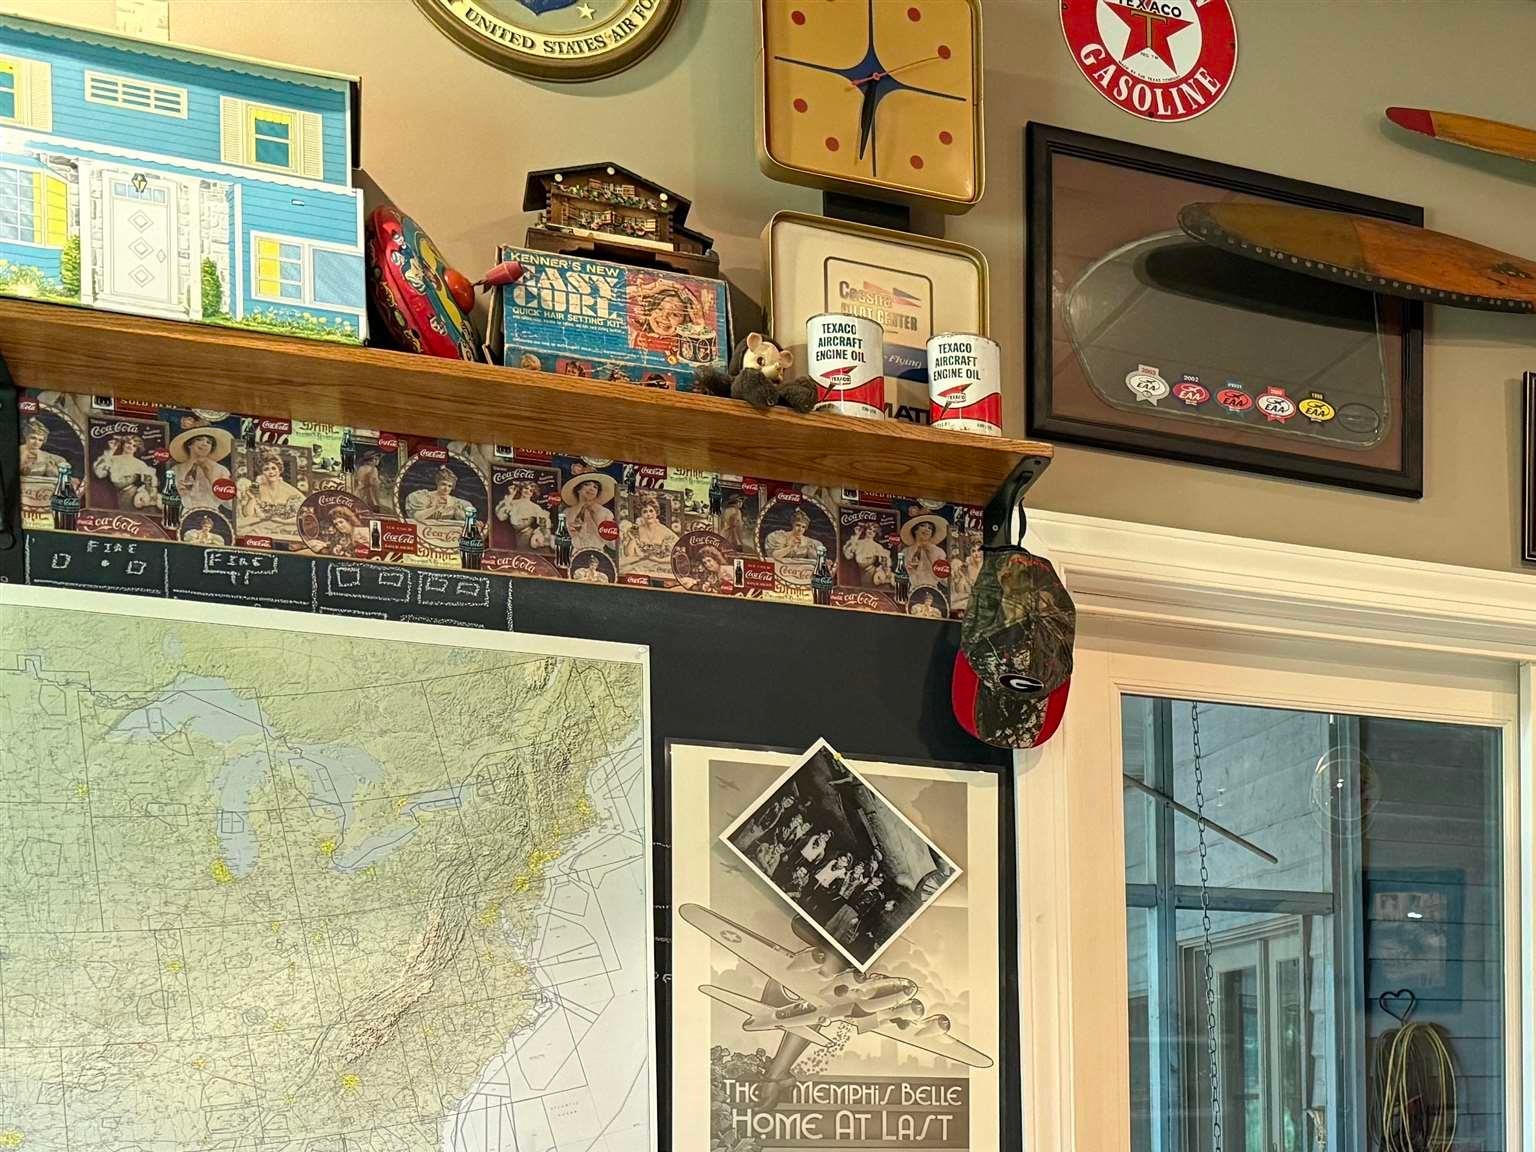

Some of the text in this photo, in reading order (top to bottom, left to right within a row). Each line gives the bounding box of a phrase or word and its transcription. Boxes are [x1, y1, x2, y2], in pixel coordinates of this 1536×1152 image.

[465, 7, 536, 50] UNITED
[543, 36, 607, 55] STATES
[611, 18, 637, 43] AIR
[1130, 10, 1168, 48] T
[1080, 43, 1222, 116] GASOLINE
[511, 252, 620, 277] KENNER'S NEW
[519, 262, 619, 299] EASY
[839, 280, 893, 309] Cessna
[513, 284, 625, 321] CURL
[512, 306, 541, 317] QUICK
[543, 310, 566, 320] HAIR
[567, 313, 605, 326] SETTING
[822, 322, 857, 335] TEXACO
[817, 336, 863, 350] AIRCRAFT
[938, 343, 973, 355] TEXACO
[815, 350, 867, 364] ENGINE OIL
[935, 356, 978, 369] AIRCRAFT
[933, 367, 982, 381] ENGINE OIL
[1136, 382, 1157, 391] EAA
[1179, 390, 1200, 400] EAA
[1223, 397, 1243, 407] EAA
[1264, 403, 1285, 413] EAA
[1305, 407, 1325, 417] EAA
[383, 531, 415, 545] Coca-Cola
[87, 540, 138, 554] FIRE
[745, 569, 774, 582] Coca-Cola
[901, 1083, 962, 1106] BELLE
[731, 1108, 954, 1141] HOME AT LAST
